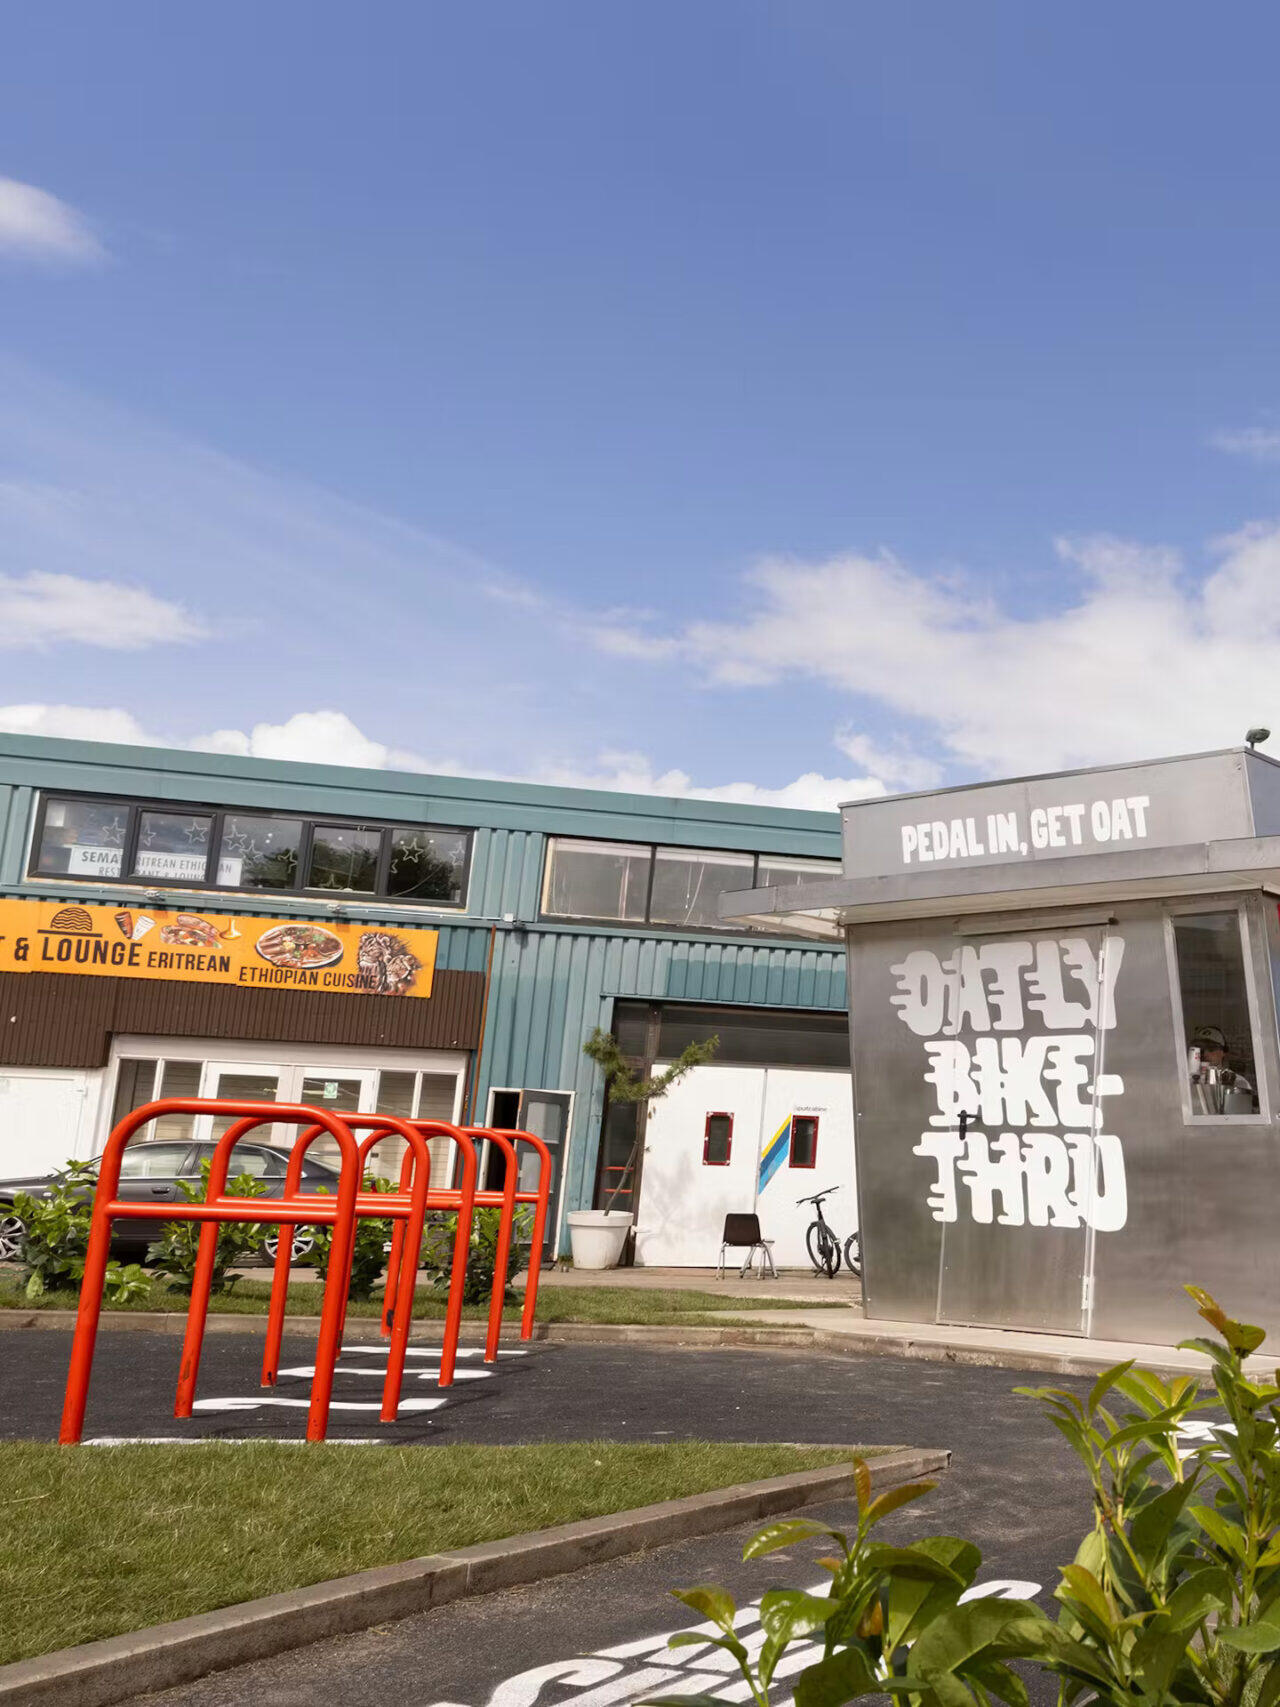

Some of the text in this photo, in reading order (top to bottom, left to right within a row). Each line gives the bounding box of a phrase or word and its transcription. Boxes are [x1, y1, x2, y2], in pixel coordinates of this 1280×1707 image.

[901, 796, 1150, 864] PEDAL IN, GET OAT
[14, 937, 29, 961] &
[42, 936, 143, 967] LOUNGE
[147, 951, 231, 973] ERITREAN
[239, 966, 319, 986] ETHIOPIAN
[323, 972, 378, 989] CUISINE
[889, 937, 1126, 1036] OATLY
[912, 1130, 1129, 1234] THRU
